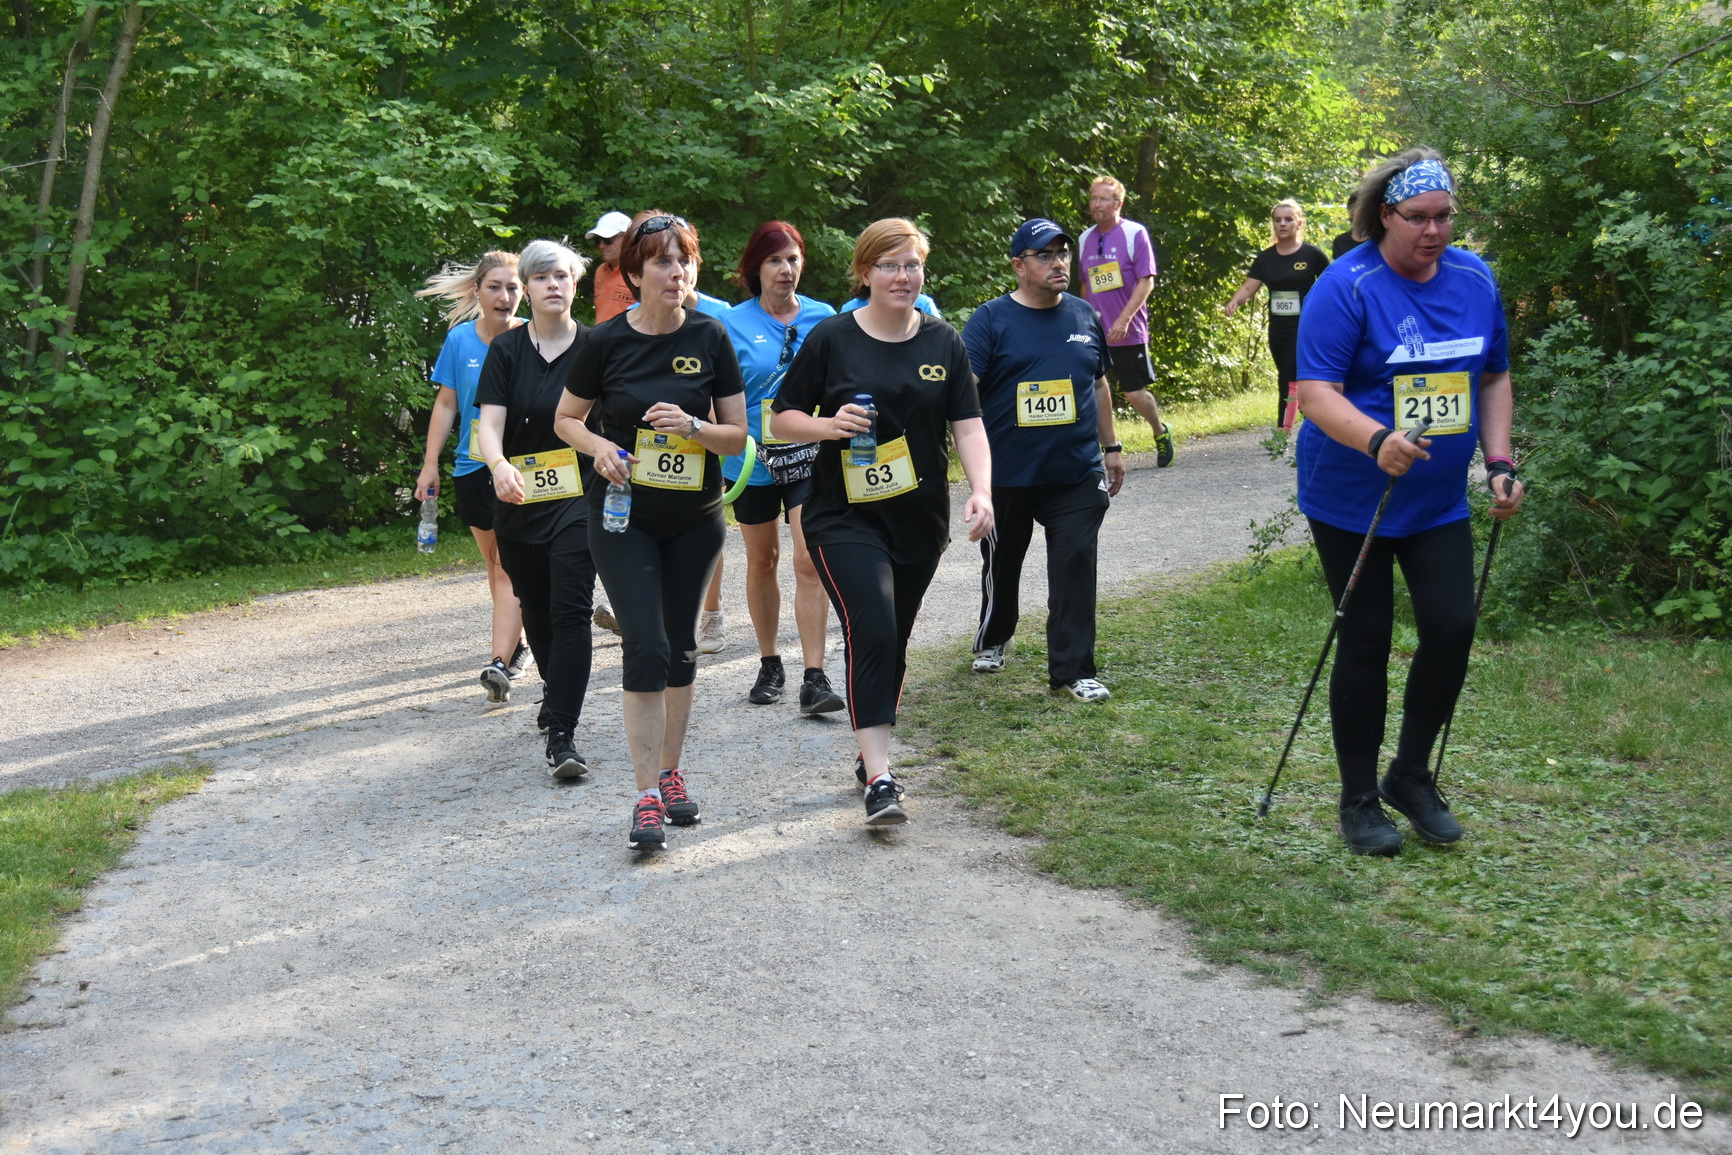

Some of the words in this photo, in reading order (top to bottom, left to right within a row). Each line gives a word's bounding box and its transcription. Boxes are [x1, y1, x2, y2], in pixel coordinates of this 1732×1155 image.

[1095, 273, 1113, 285] 898
[1276, 302, 1293, 310] 9067
[1429, 340, 1477, 351] Schornsteintechnik
[759, 371, 777, 390] Team
[1024, 395, 1066, 413] 1401
[1405, 394, 1459, 419] 2131
[658, 453, 685, 474] 68
[535, 469, 558, 488] 58
[647, 471, 667, 479] Körner
[865, 464, 893, 486] 63
